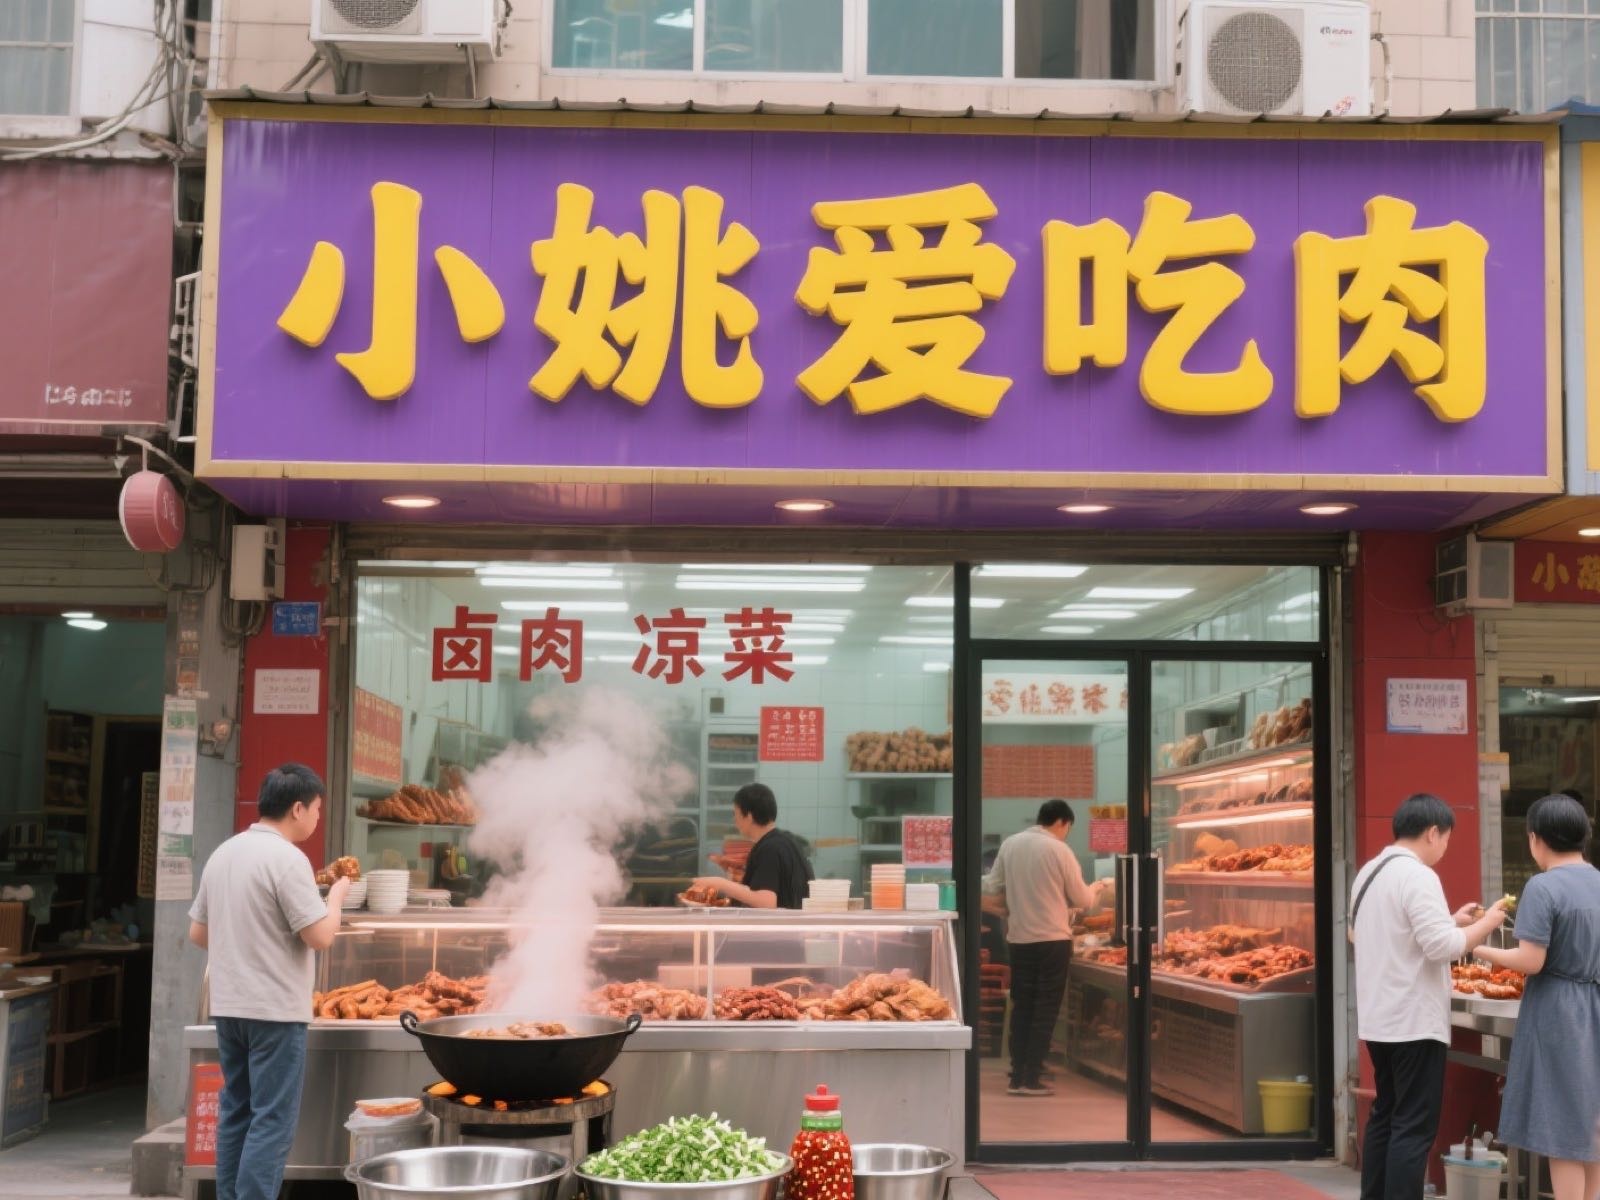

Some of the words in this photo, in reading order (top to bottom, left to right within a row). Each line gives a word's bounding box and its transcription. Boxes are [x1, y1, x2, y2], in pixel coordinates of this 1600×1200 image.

[278, 181, 1489, 422] 小姚爱吃肉
[431, 605, 583, 684] 卤肉
[632, 607, 795, 684] 凉菜
